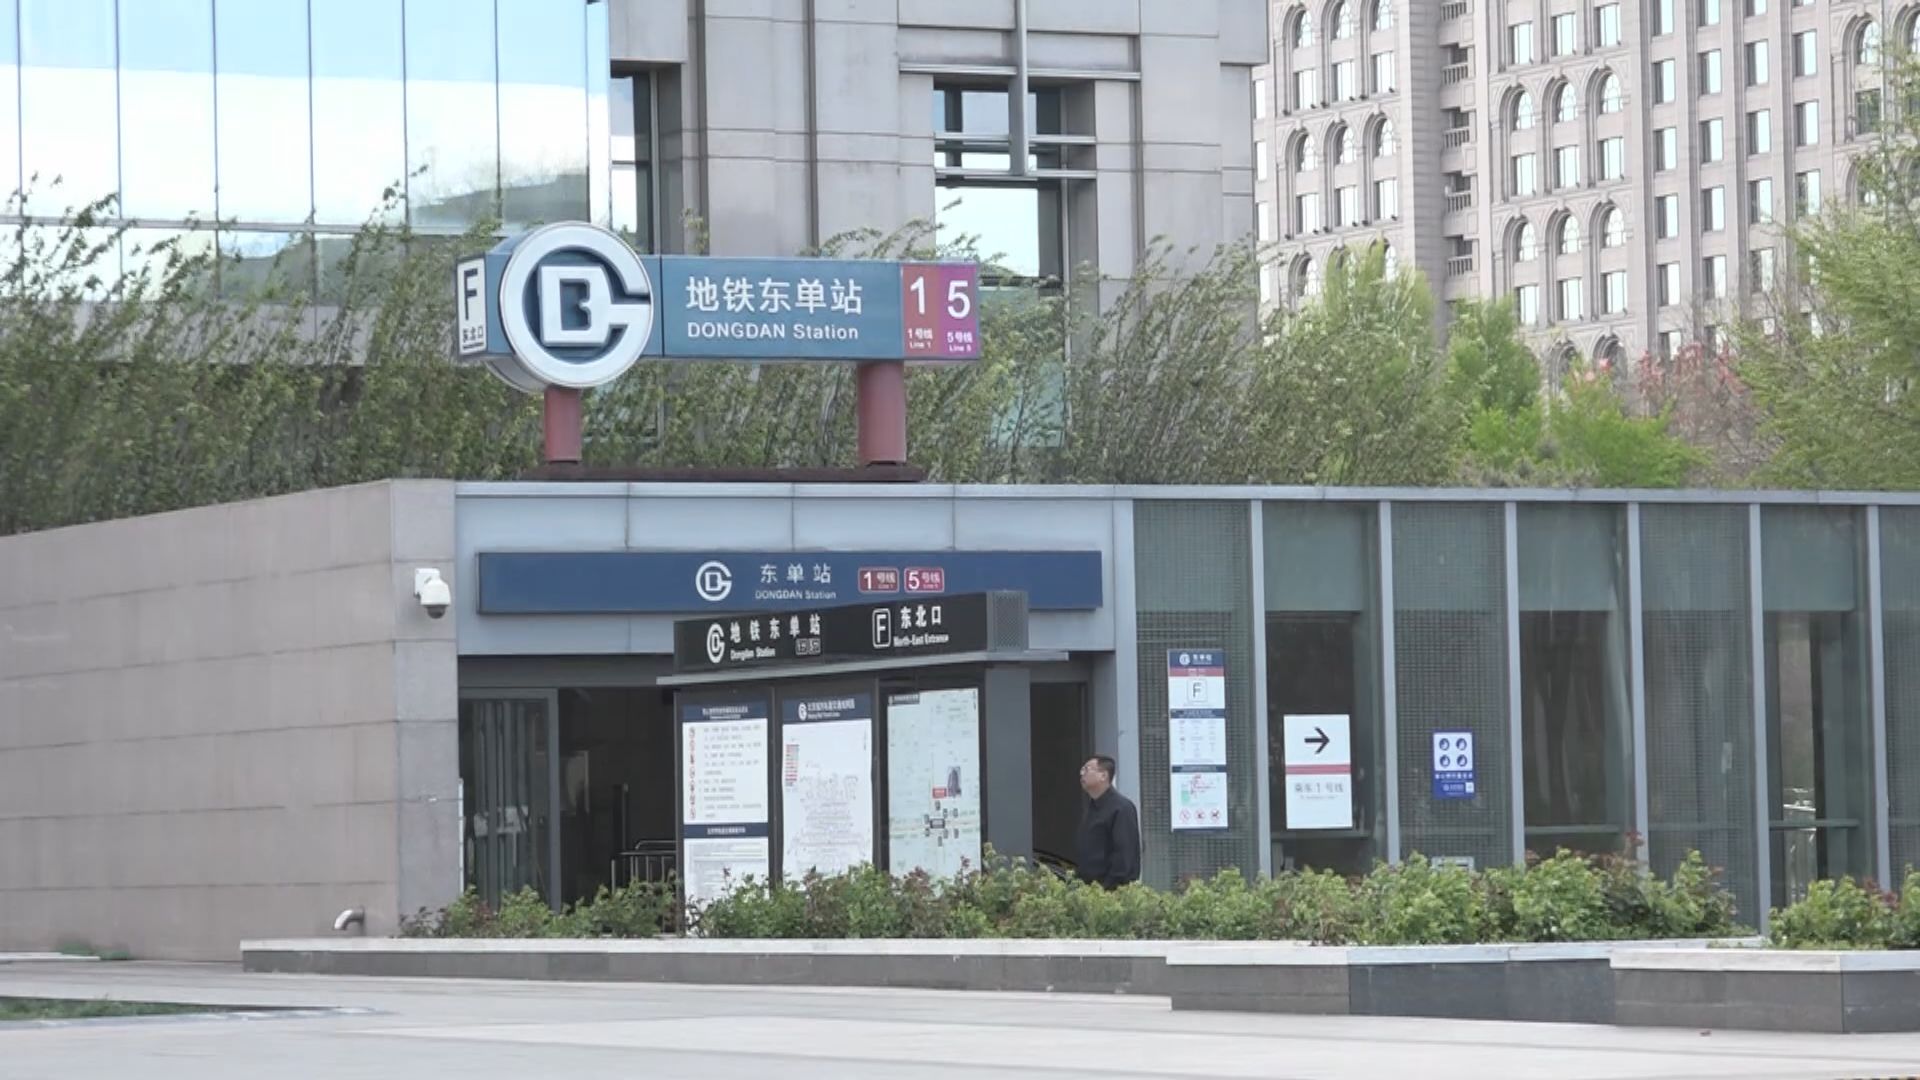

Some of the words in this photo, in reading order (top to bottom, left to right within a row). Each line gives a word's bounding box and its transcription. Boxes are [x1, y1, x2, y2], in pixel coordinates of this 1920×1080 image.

[463, 267, 478, 320] F
[685, 276, 863, 314] 地铁东单站
[910, 275, 925, 315] 1
[947, 279, 971, 319] 5
[687, 321, 785, 338] DONGDAN
[792, 324, 859, 340] Station
[760, 563, 832, 584] 东单站
[755, 589, 803, 599] DONGDAN
[805, 590, 837, 600] Station
[730, 613, 821, 642] 地铁东单站
[876, 613, 887, 643] F
[900, 604, 942, 629] 东北口
[1192, 681, 1202, 698] F
